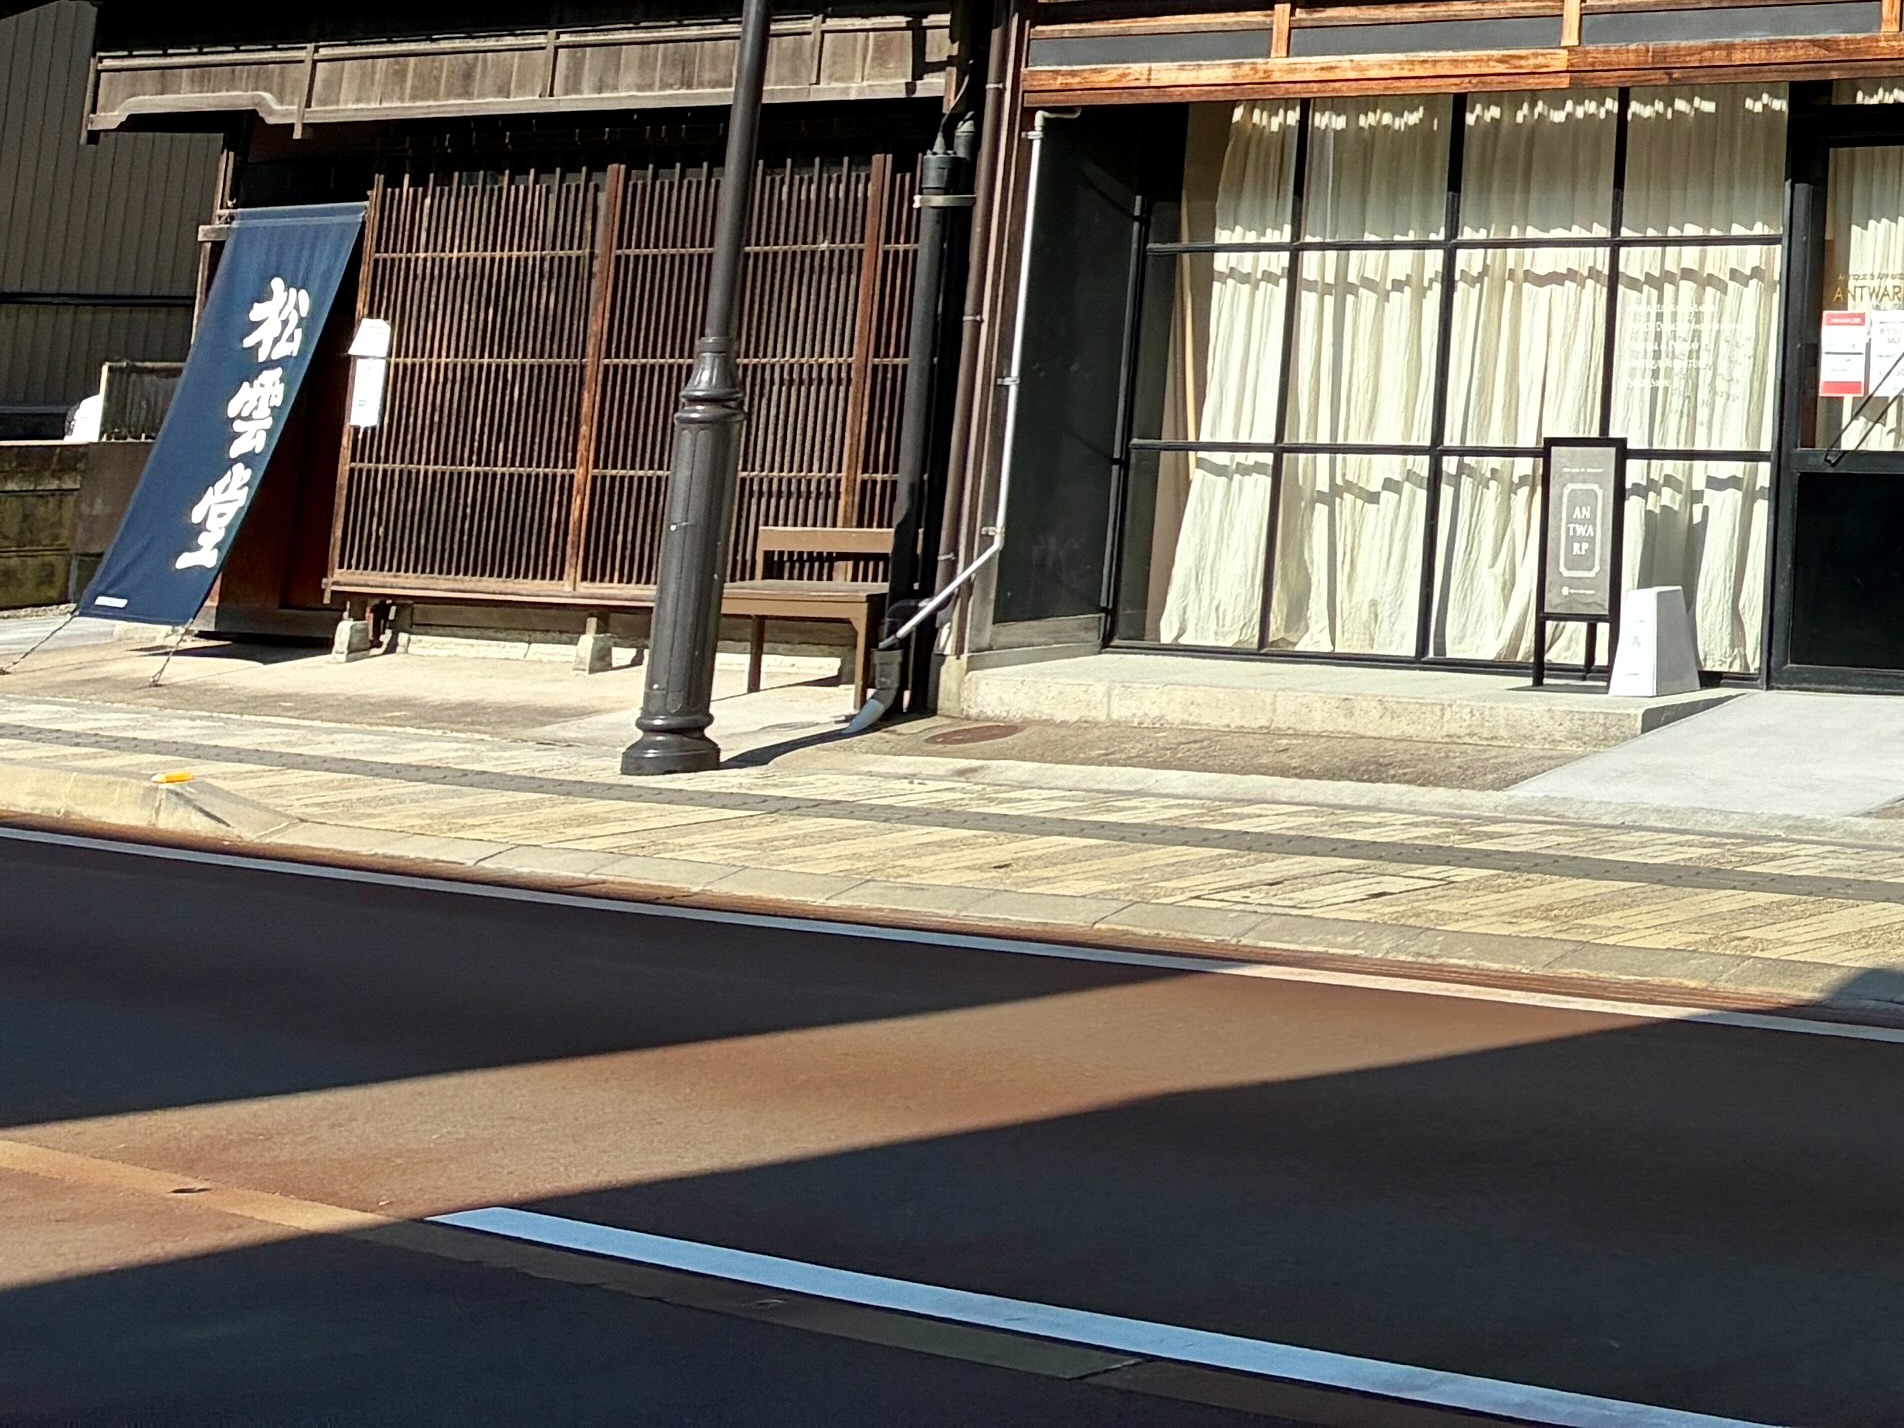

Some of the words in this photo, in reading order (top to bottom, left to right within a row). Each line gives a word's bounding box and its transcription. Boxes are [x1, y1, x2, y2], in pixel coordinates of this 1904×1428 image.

[174, 276, 310, 570] 松雲堂
[1572, 505, 1591, 519] AN
[1567, 523, 1594, 537] TWA
[1572, 541, 1590, 555] RP
